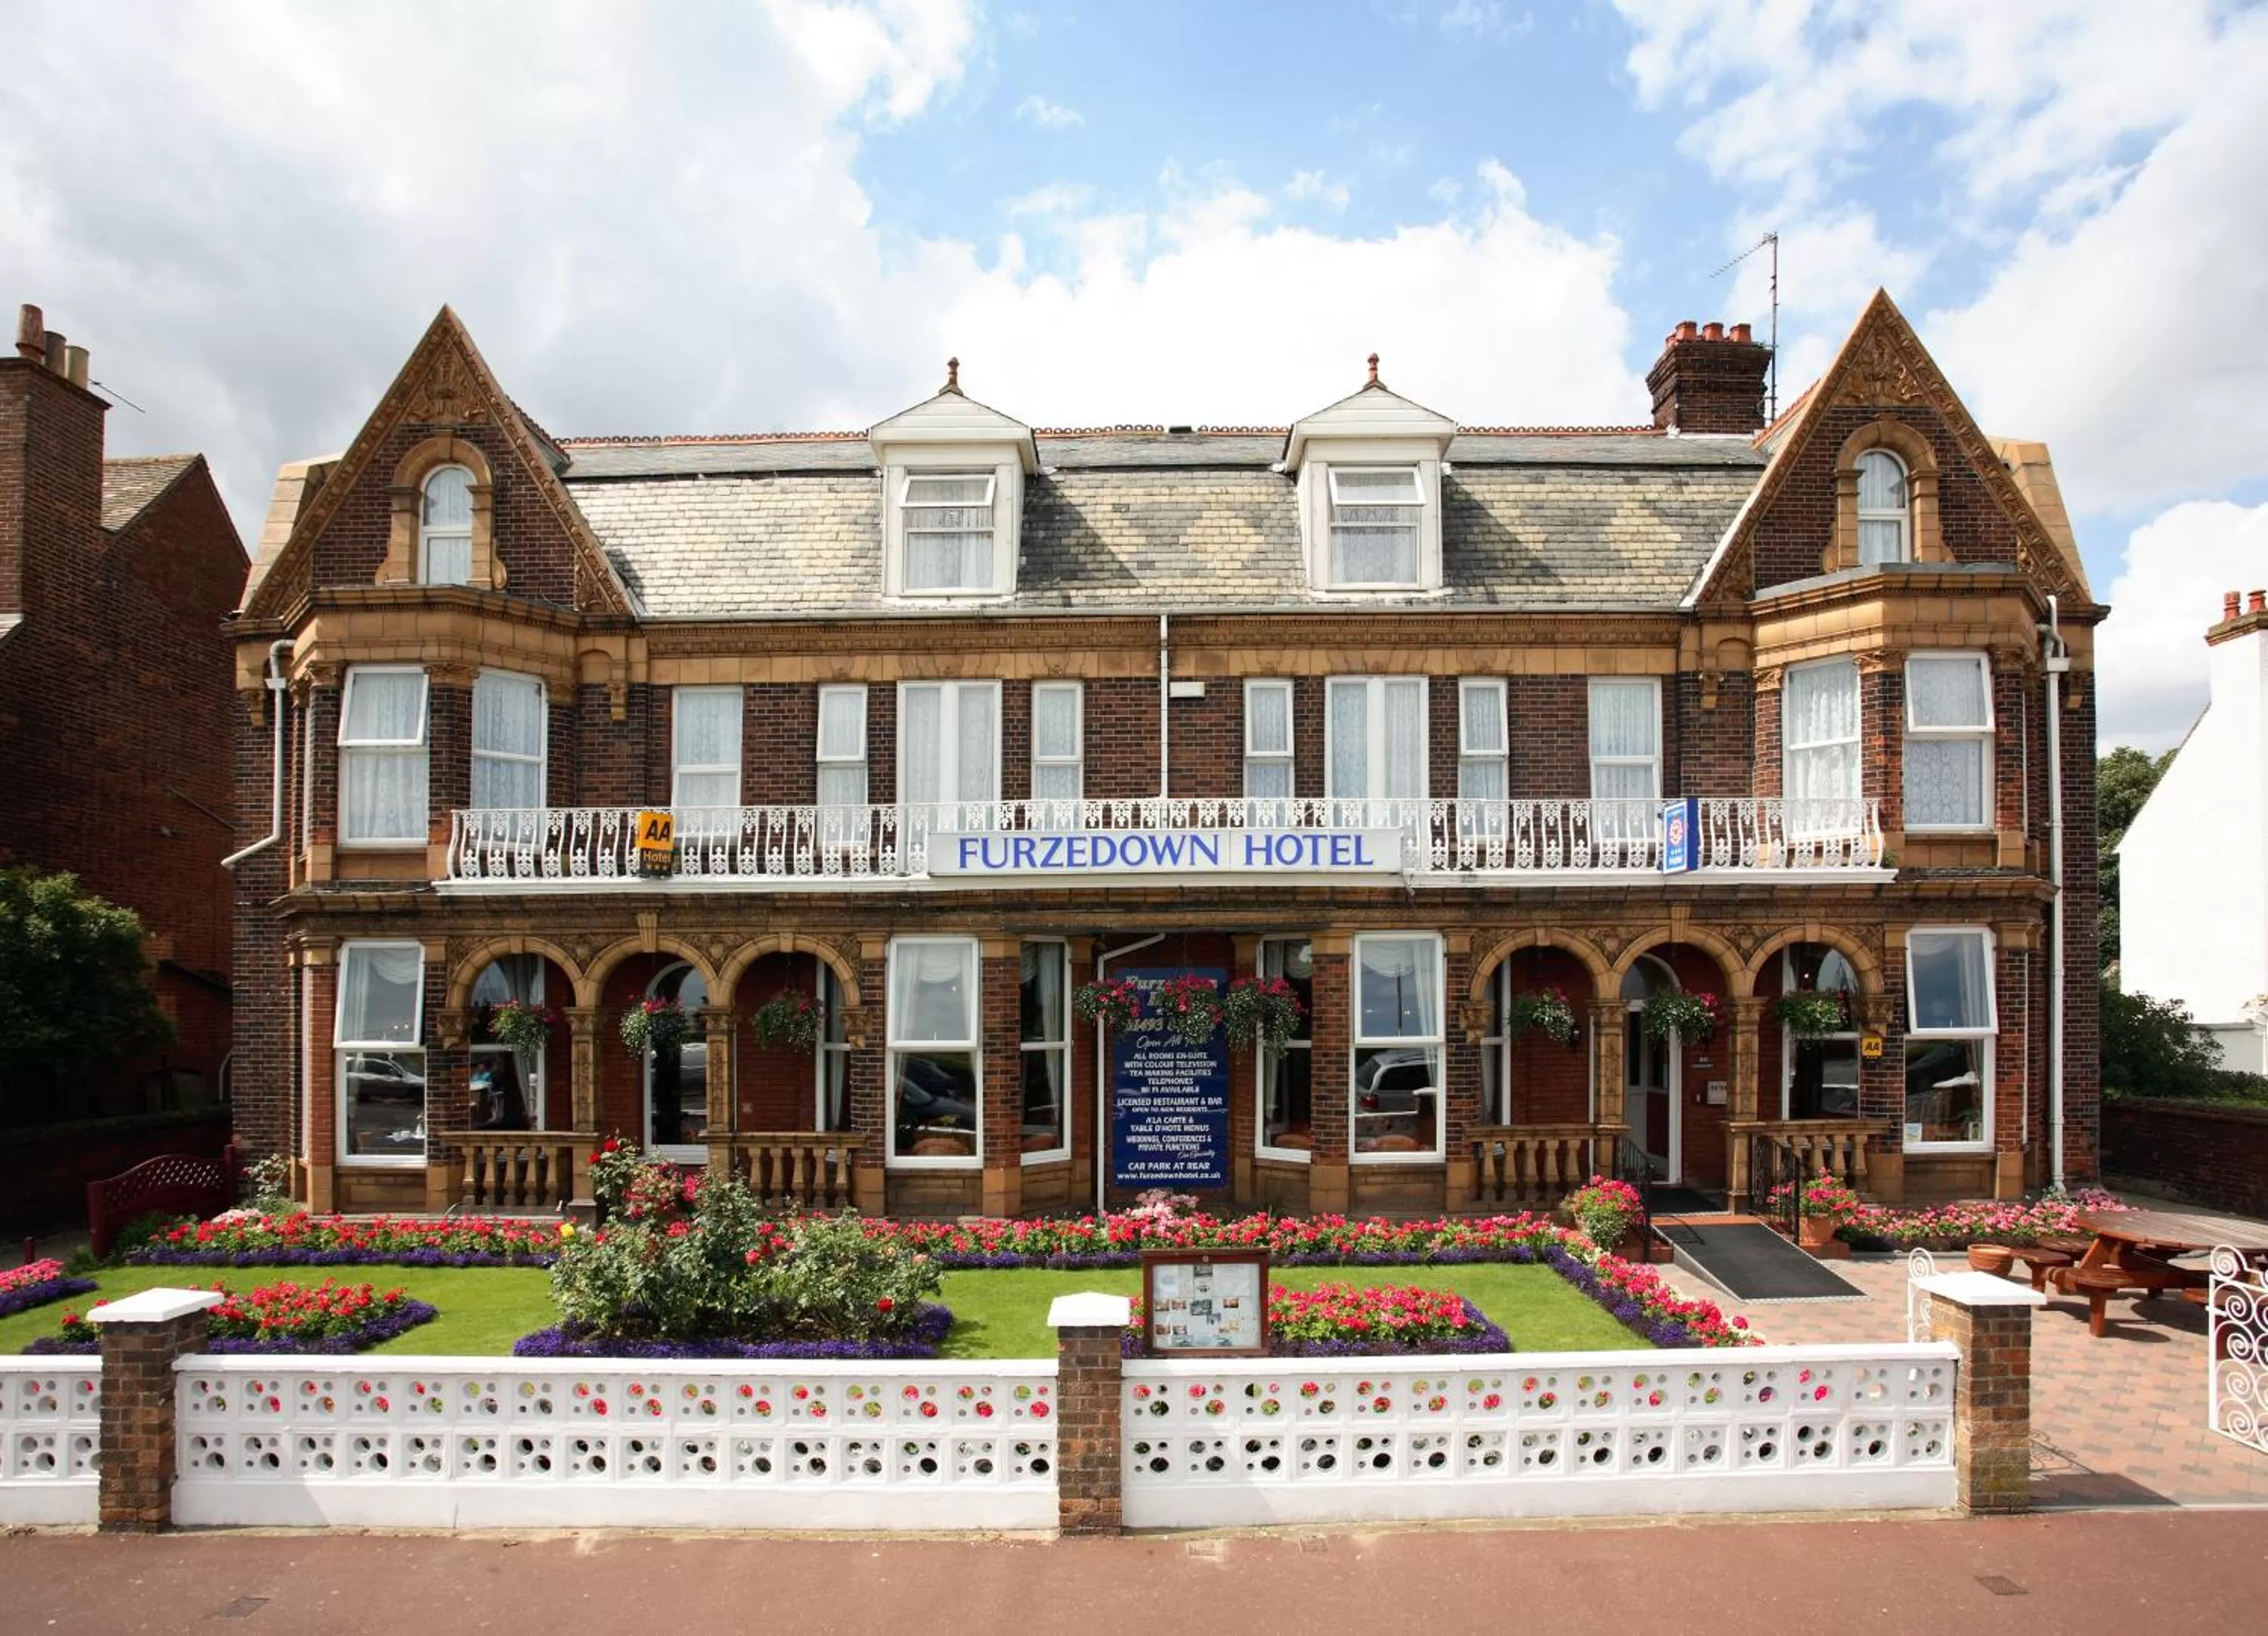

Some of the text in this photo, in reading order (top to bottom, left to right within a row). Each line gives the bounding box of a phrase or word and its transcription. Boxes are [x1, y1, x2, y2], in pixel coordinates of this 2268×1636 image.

[645, 819, 671, 842] AA
[959, 834, 1374, 869] FURZEDOWN HOTEL
[643, 850, 671, 863] Hotel
[1136, 1035, 1162, 1050] Open
[1164, 1033, 1183, 1047] All
[1133, 1052, 1147, 1060] ALL
[1117, 1097, 1151, 1106] LICENSED
[1153, 1097, 1199, 1106] RESTAURANT
[1207, 1097, 1223, 1105] BAR
[1130, 1124, 1153, 1132] TABLE
[1138, 1142, 1200, 1151] PRIVATE FUNCTIONS
[1127, 1162, 1146, 1170] CAR
